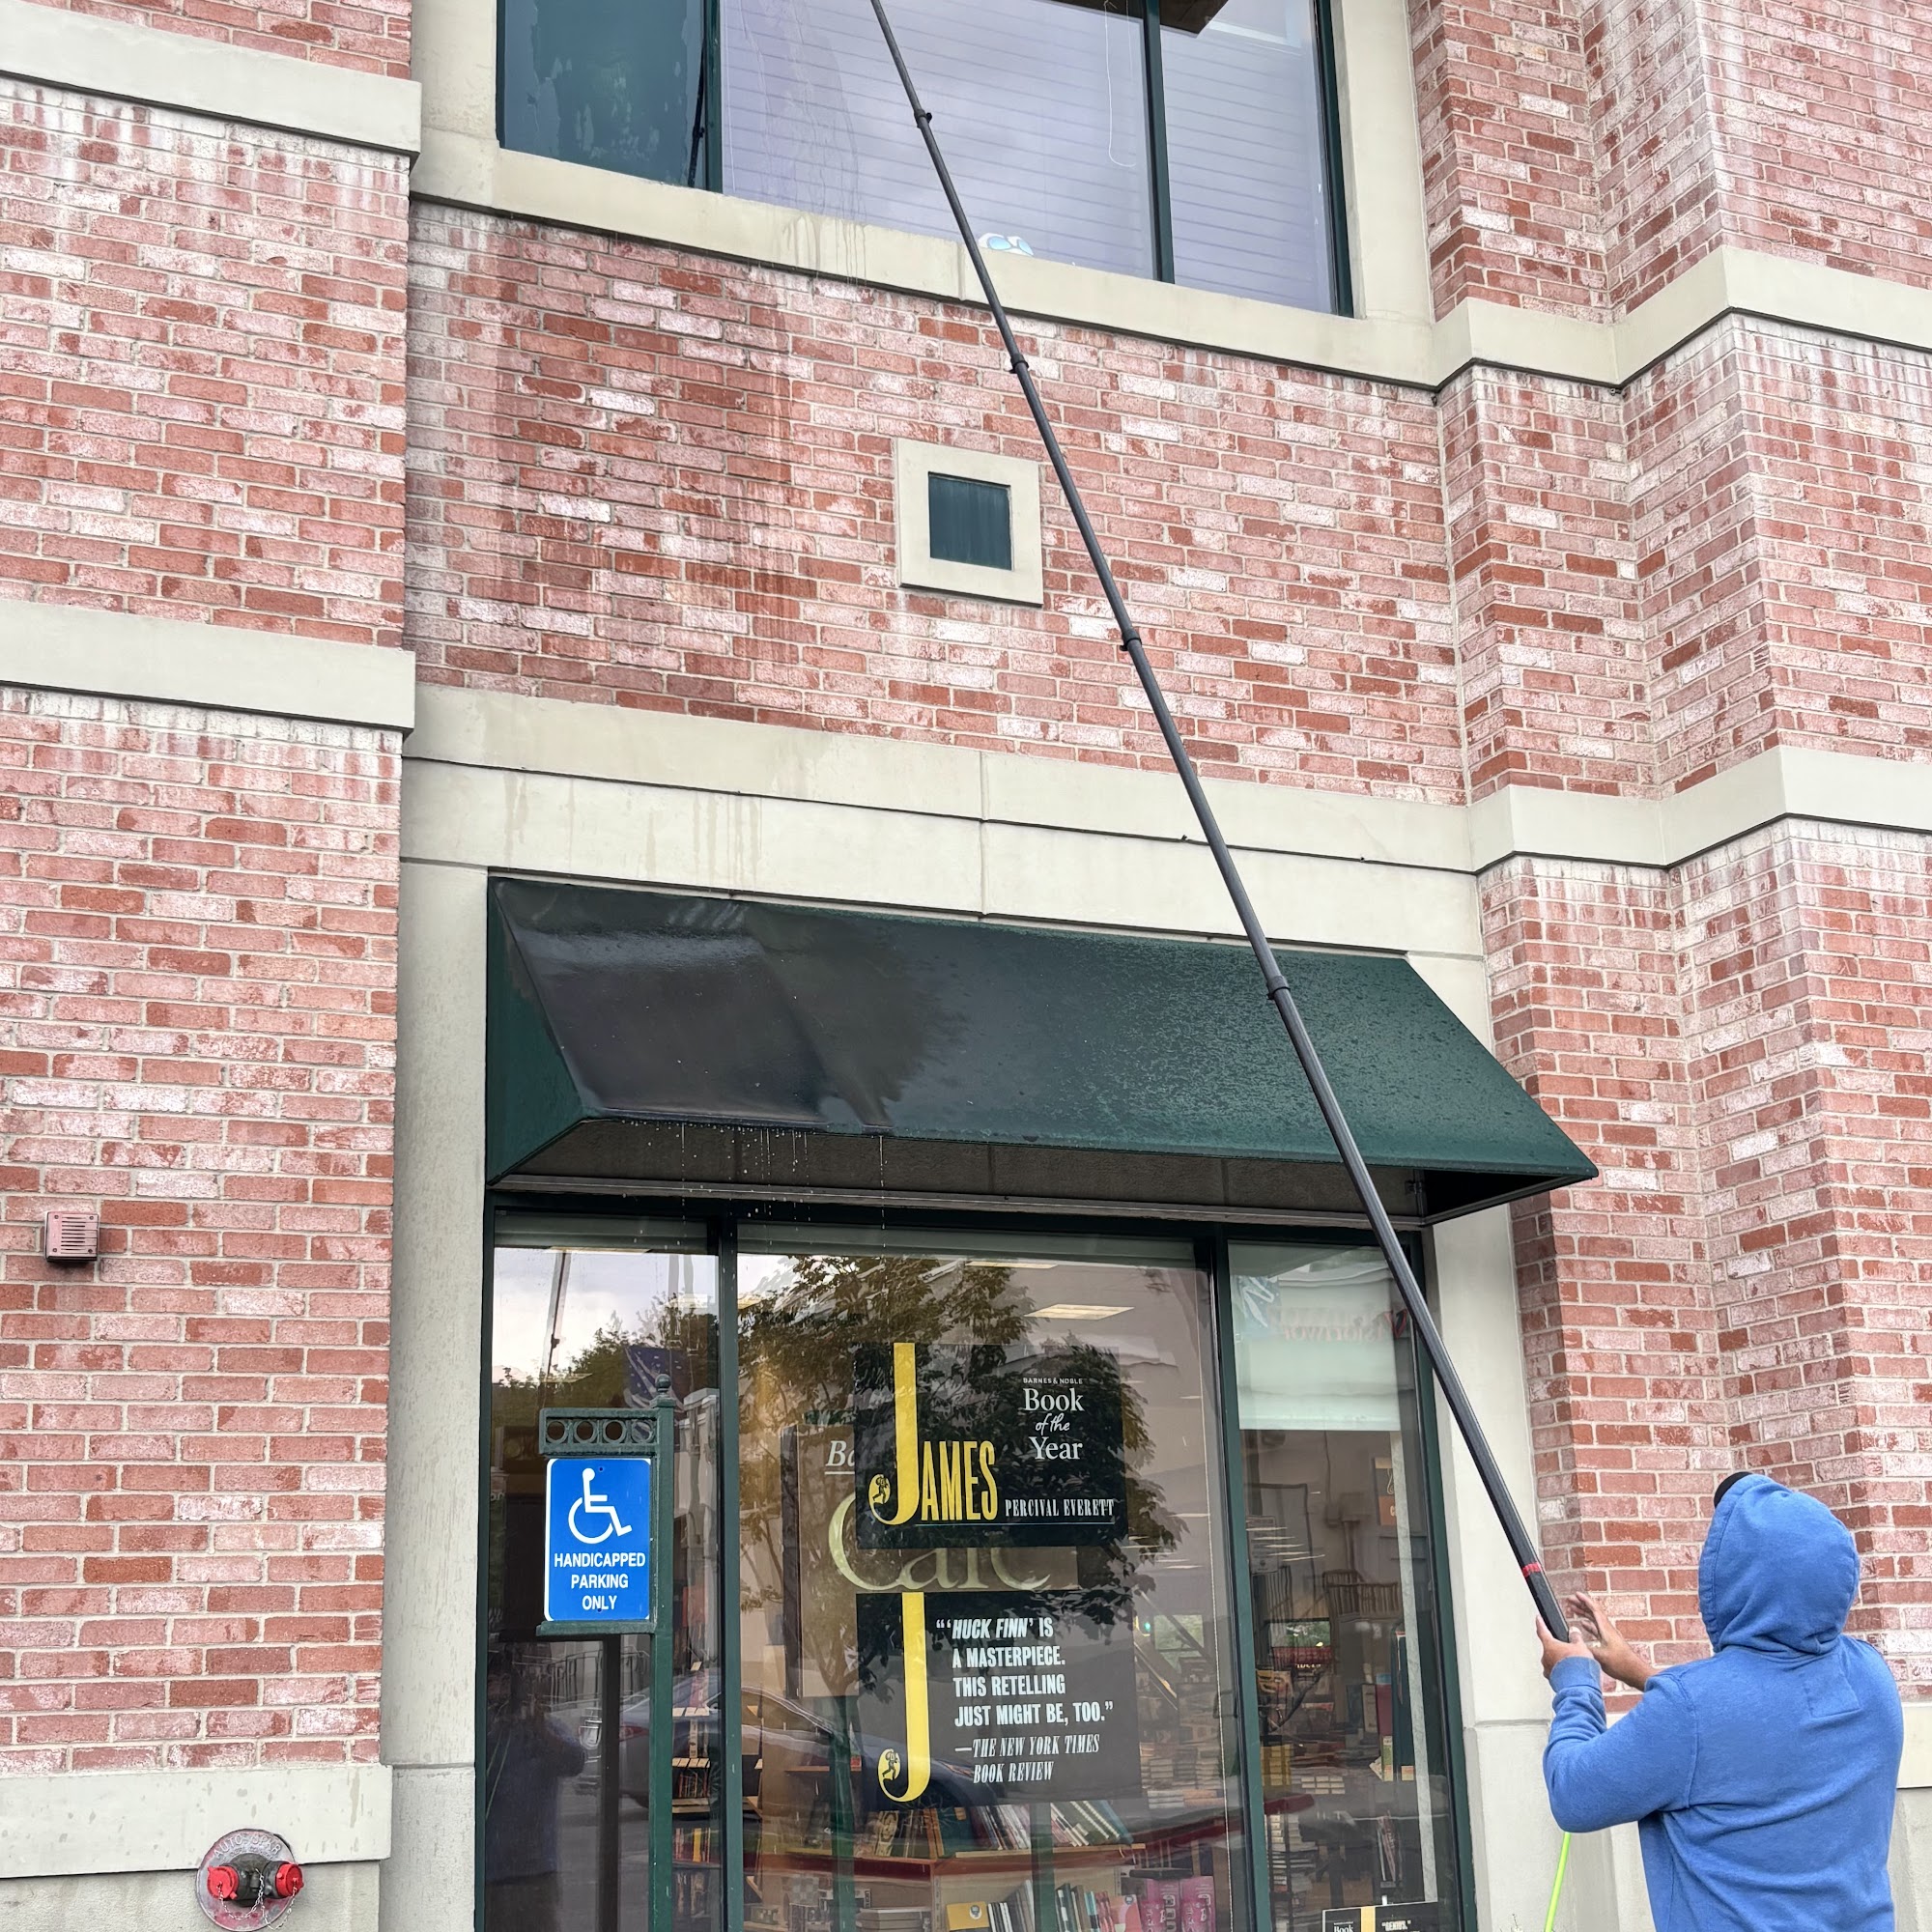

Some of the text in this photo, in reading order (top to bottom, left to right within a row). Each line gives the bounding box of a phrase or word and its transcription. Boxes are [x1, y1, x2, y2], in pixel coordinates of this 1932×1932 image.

[1023, 1387, 1085, 1411] Book
[868, 1342, 999, 1525] JAMES
[1035, 1412, 1071, 1435] of the
[1028, 1436, 1084, 1460] Year
[1005, 1498, 1115, 1517] PERCIVAL EVERETT
[554, 1551, 646, 1568] HANDICAPPED
[571, 1574, 629, 1589] PARKING
[582, 1595, 617, 1610] ONLY
[1038, 1617, 1054, 1637] IS
[952, 1645, 1065, 1669] A MASTERPIECE.
[952, 1674, 1065, 1697] THIS RETELLING
[954, 1700, 1114, 1727] JUST MIGHT BE, TOO.”
[999, 1737, 1026, 1758] NEW
[1029, 1735, 1061, 1756] YORK
[1064, 1734, 1100, 1754] TIMES
[973, 1761, 1055, 1784] BOOK REVIEW
[213, 1833, 243, 1859] AUTO
